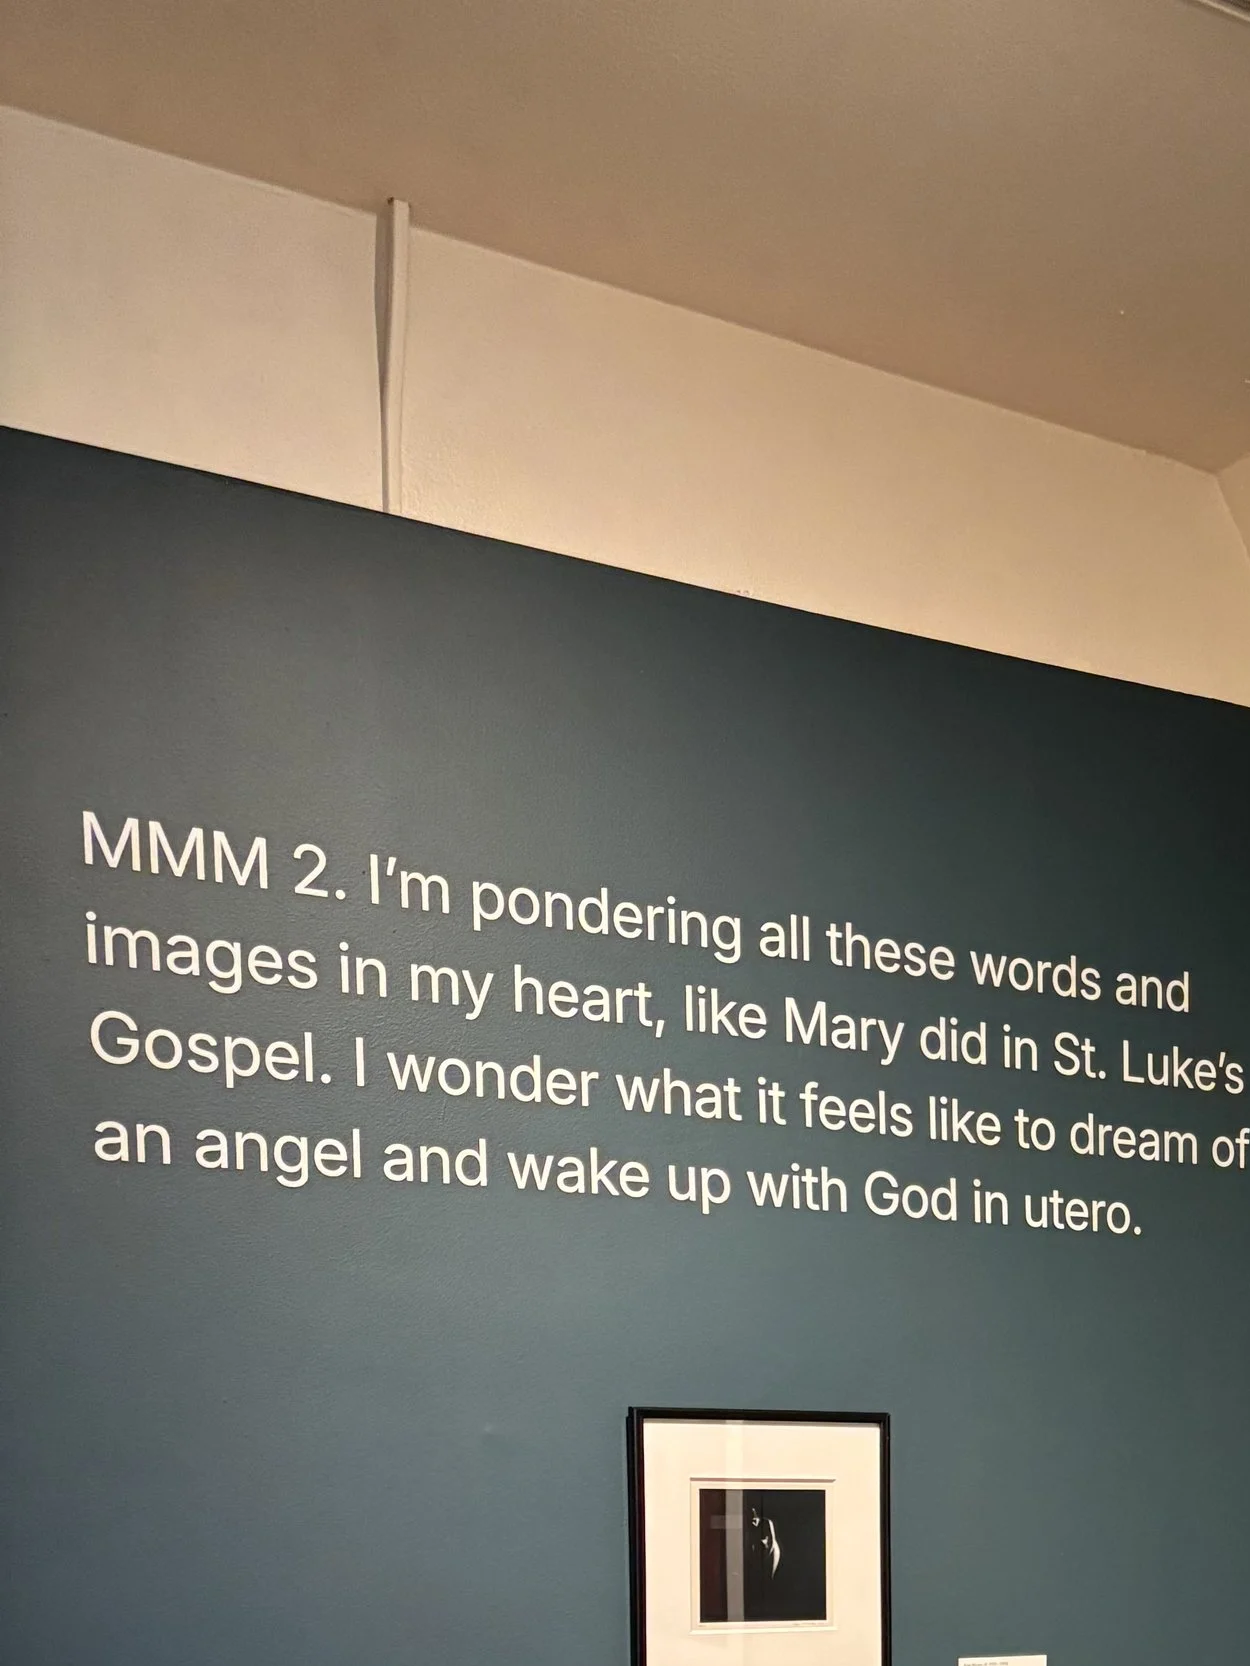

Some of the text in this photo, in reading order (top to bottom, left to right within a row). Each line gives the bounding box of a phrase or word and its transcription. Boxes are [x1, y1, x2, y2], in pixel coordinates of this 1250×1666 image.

[82, 810, 1189, 1013] MMM 2. I’m pondering all these words and
[85, 910, 1244, 1095] images in my heart, like Mary did in St. Luke’s
[90, 1009, 1250, 1169] Gospel. I wonder what it feels like to dream of
[94, 1120, 1142, 1236] an angel and wake up with God in utero.
